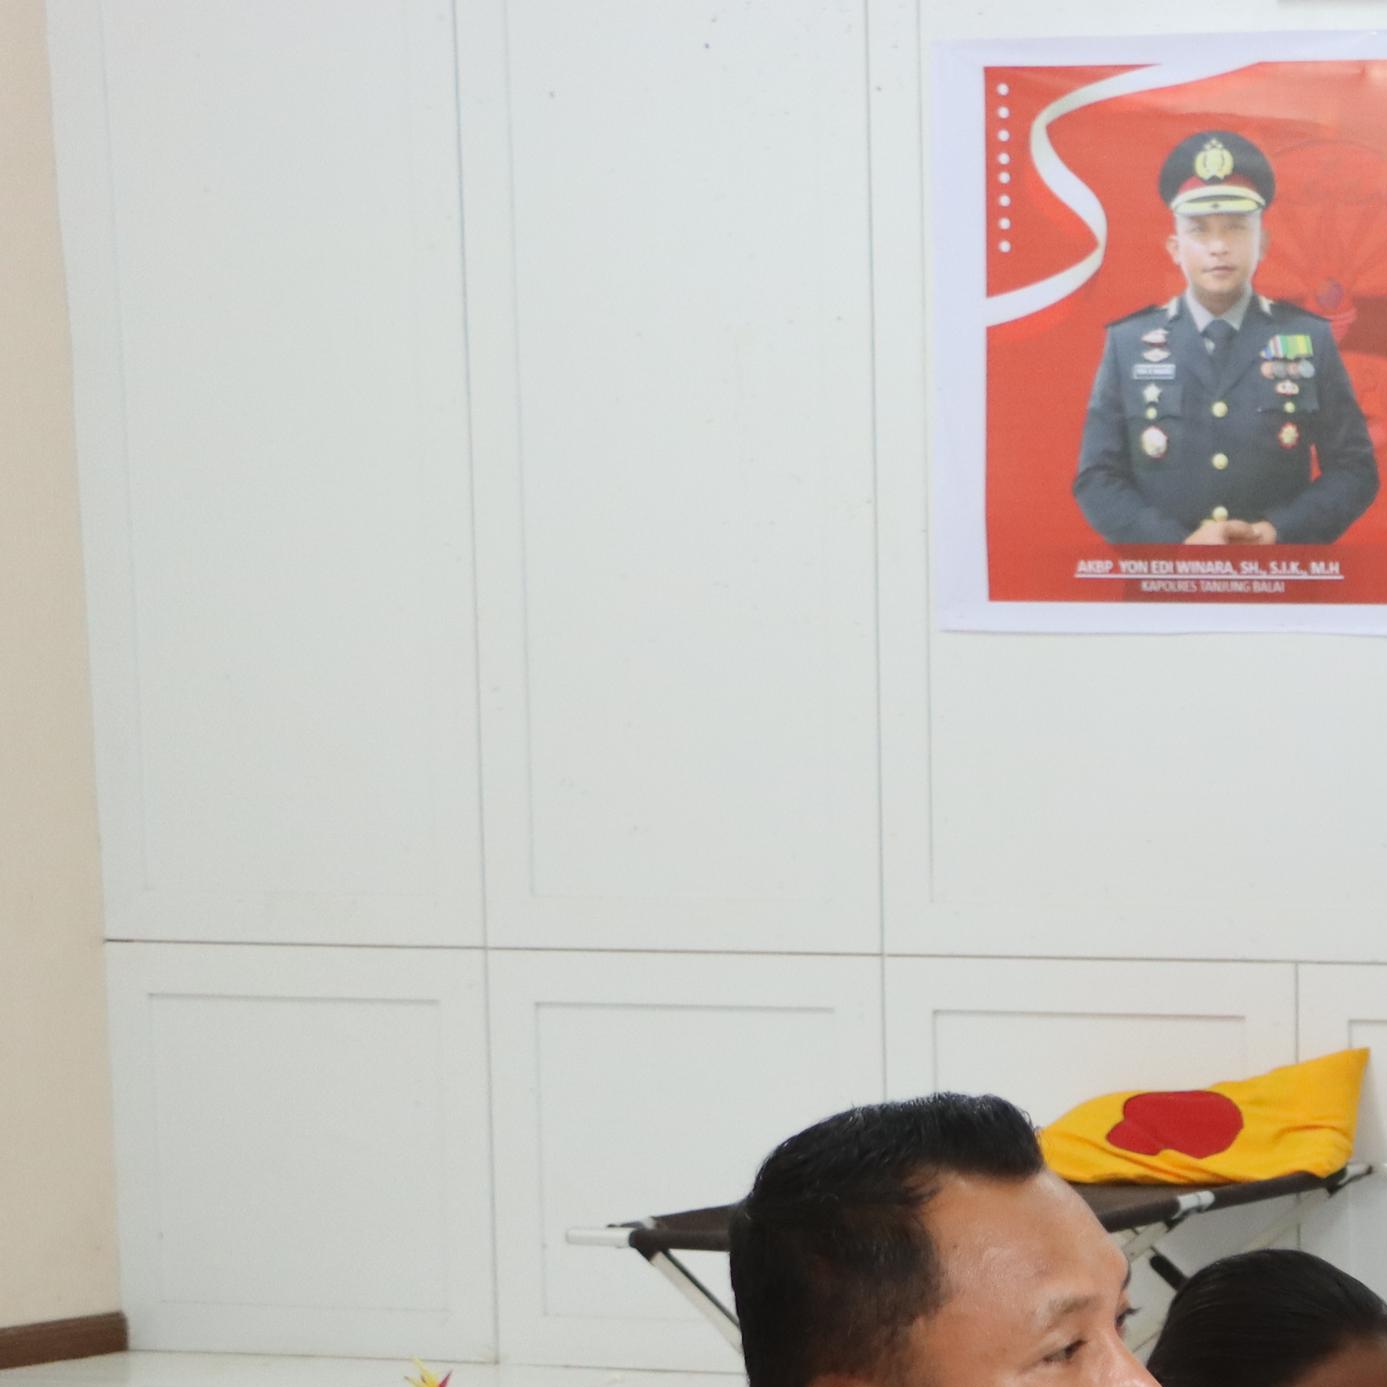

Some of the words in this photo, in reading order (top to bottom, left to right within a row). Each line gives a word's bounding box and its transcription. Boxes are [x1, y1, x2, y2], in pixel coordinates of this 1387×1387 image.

[1077, 560, 1113, 574] AKBP
[1119, 560, 1149, 574] YON
[1151, 560, 1173, 574] EDI
[1200, 581, 1249, 592] TANJUNG
[1252, 582, 1285, 593] BALAI
